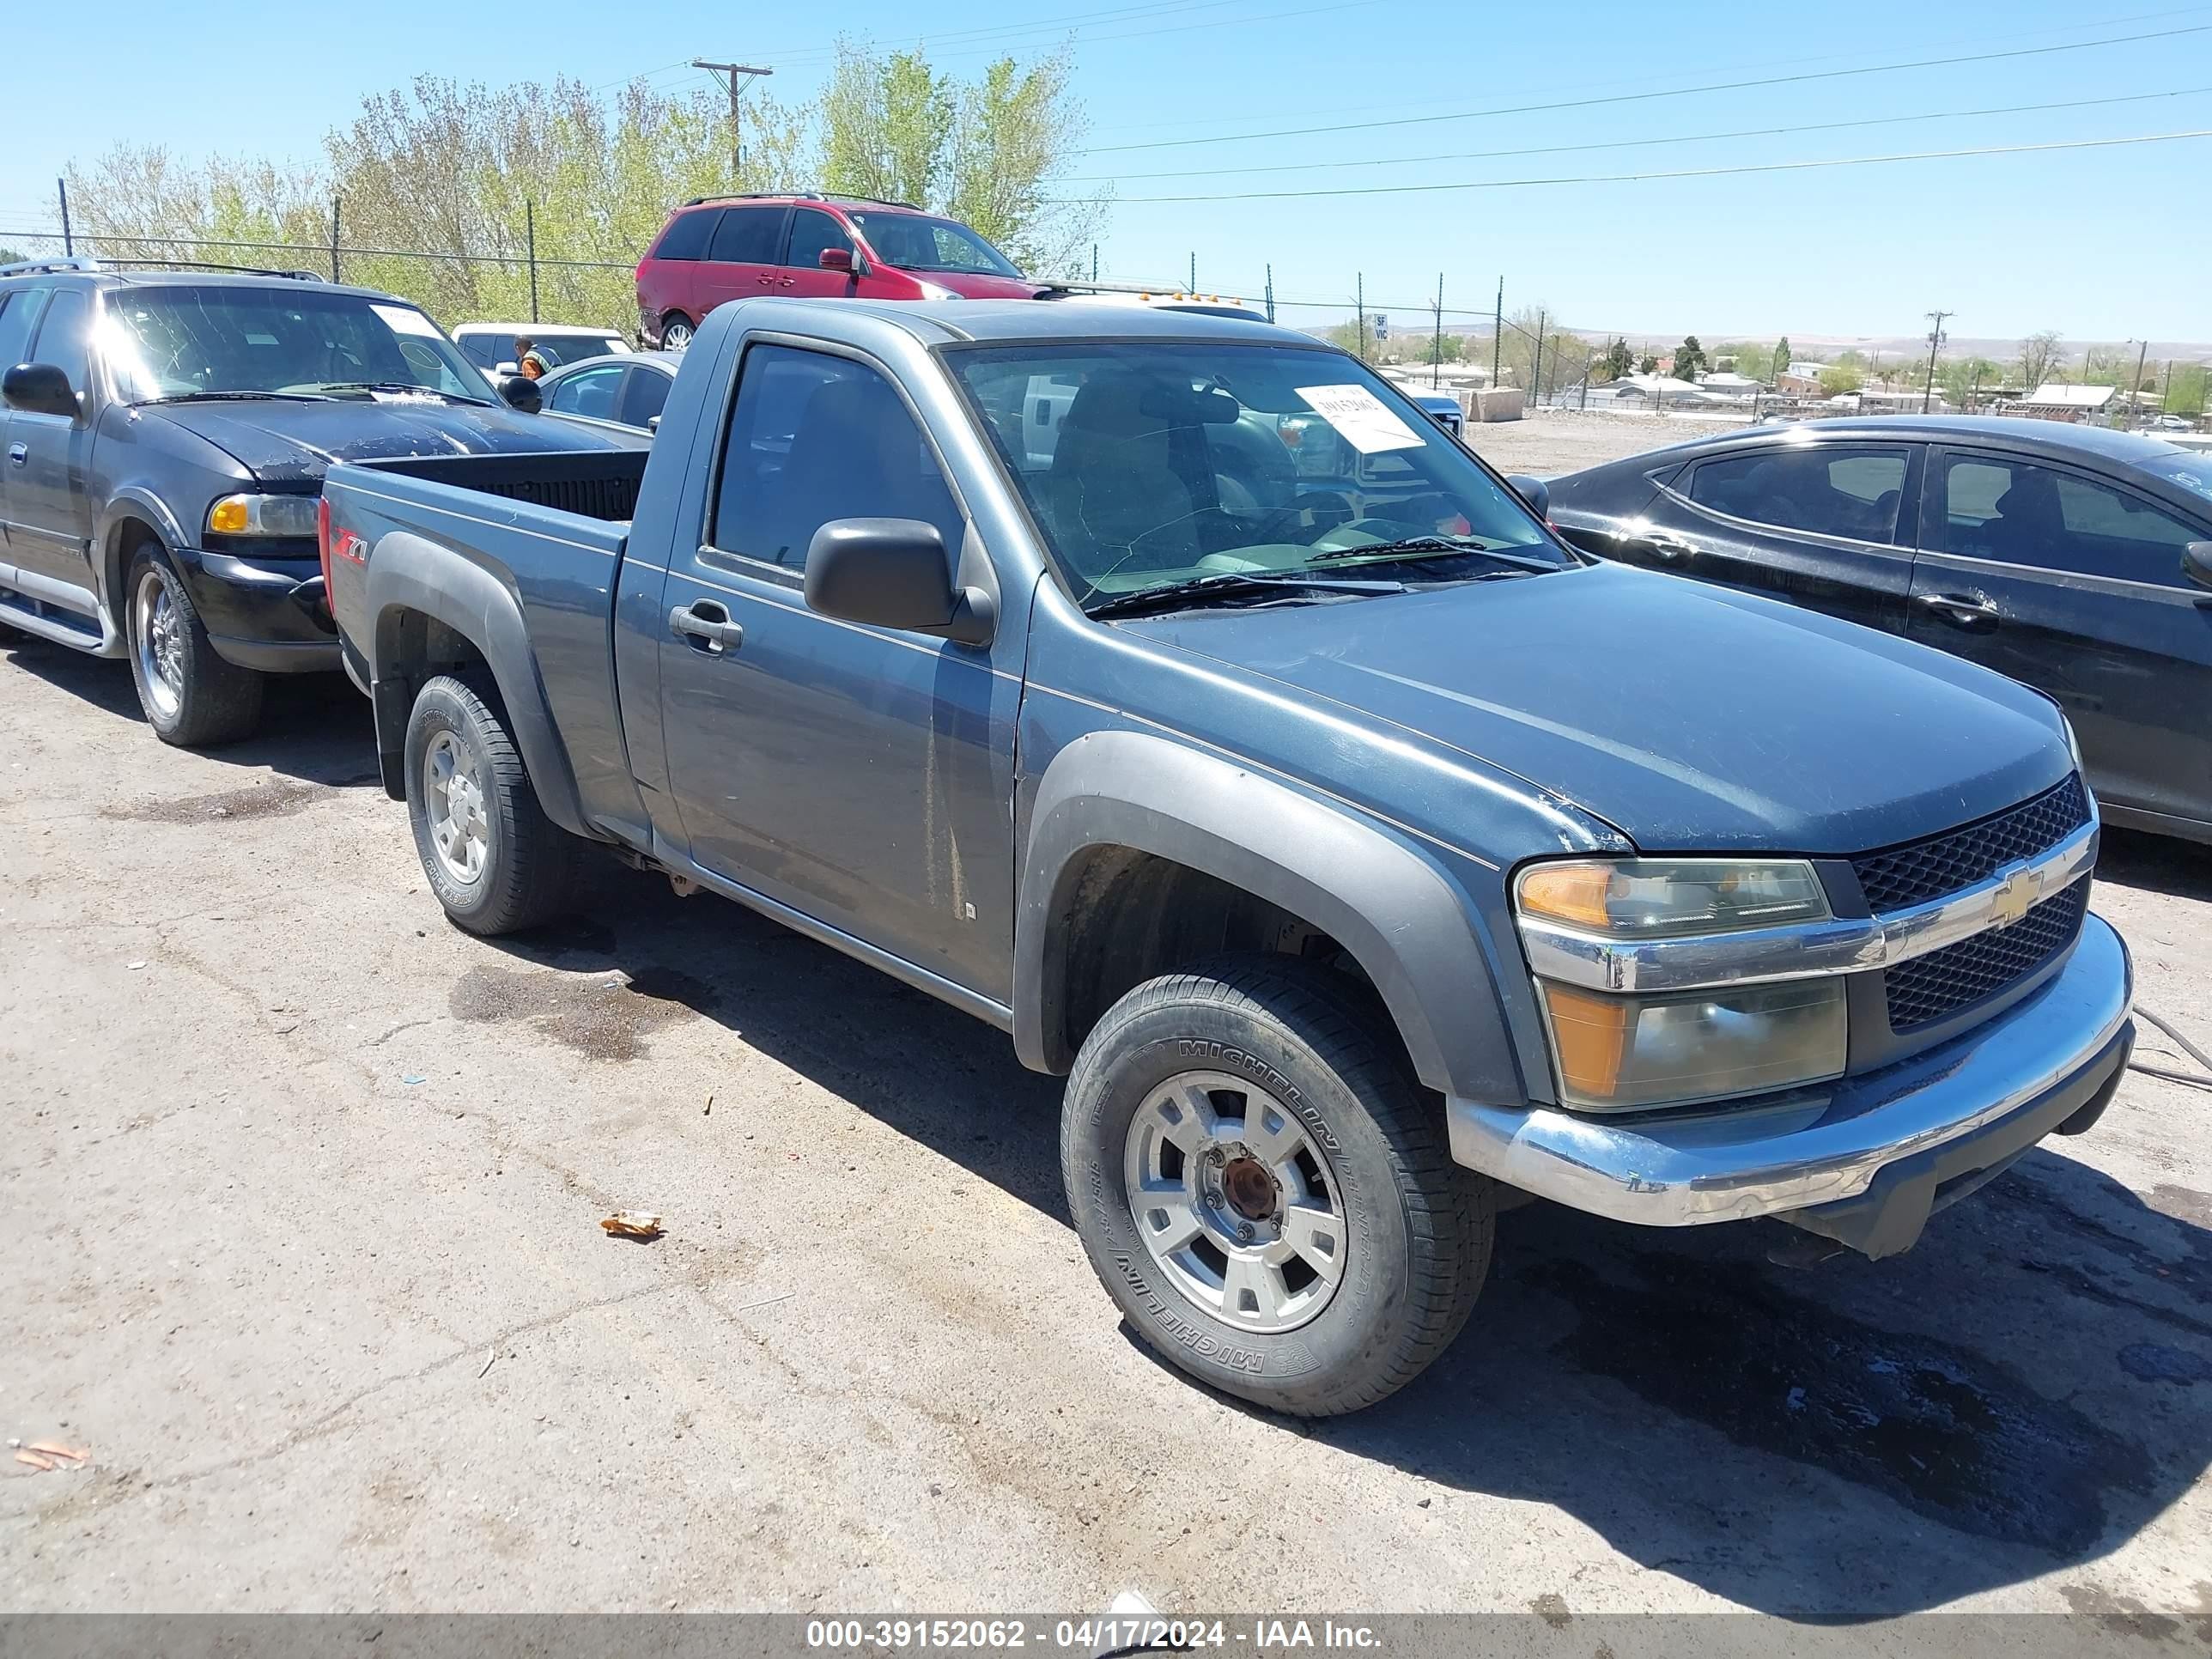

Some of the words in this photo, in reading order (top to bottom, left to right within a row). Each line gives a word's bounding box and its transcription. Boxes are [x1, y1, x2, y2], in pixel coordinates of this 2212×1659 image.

[1376, 329, 1388, 339] VIC
[333, 526, 368, 564] Z71
[1178, 1040, 1340, 1150] MICHELIN
[1115, 1255, 1266, 1374] MICHELIN
